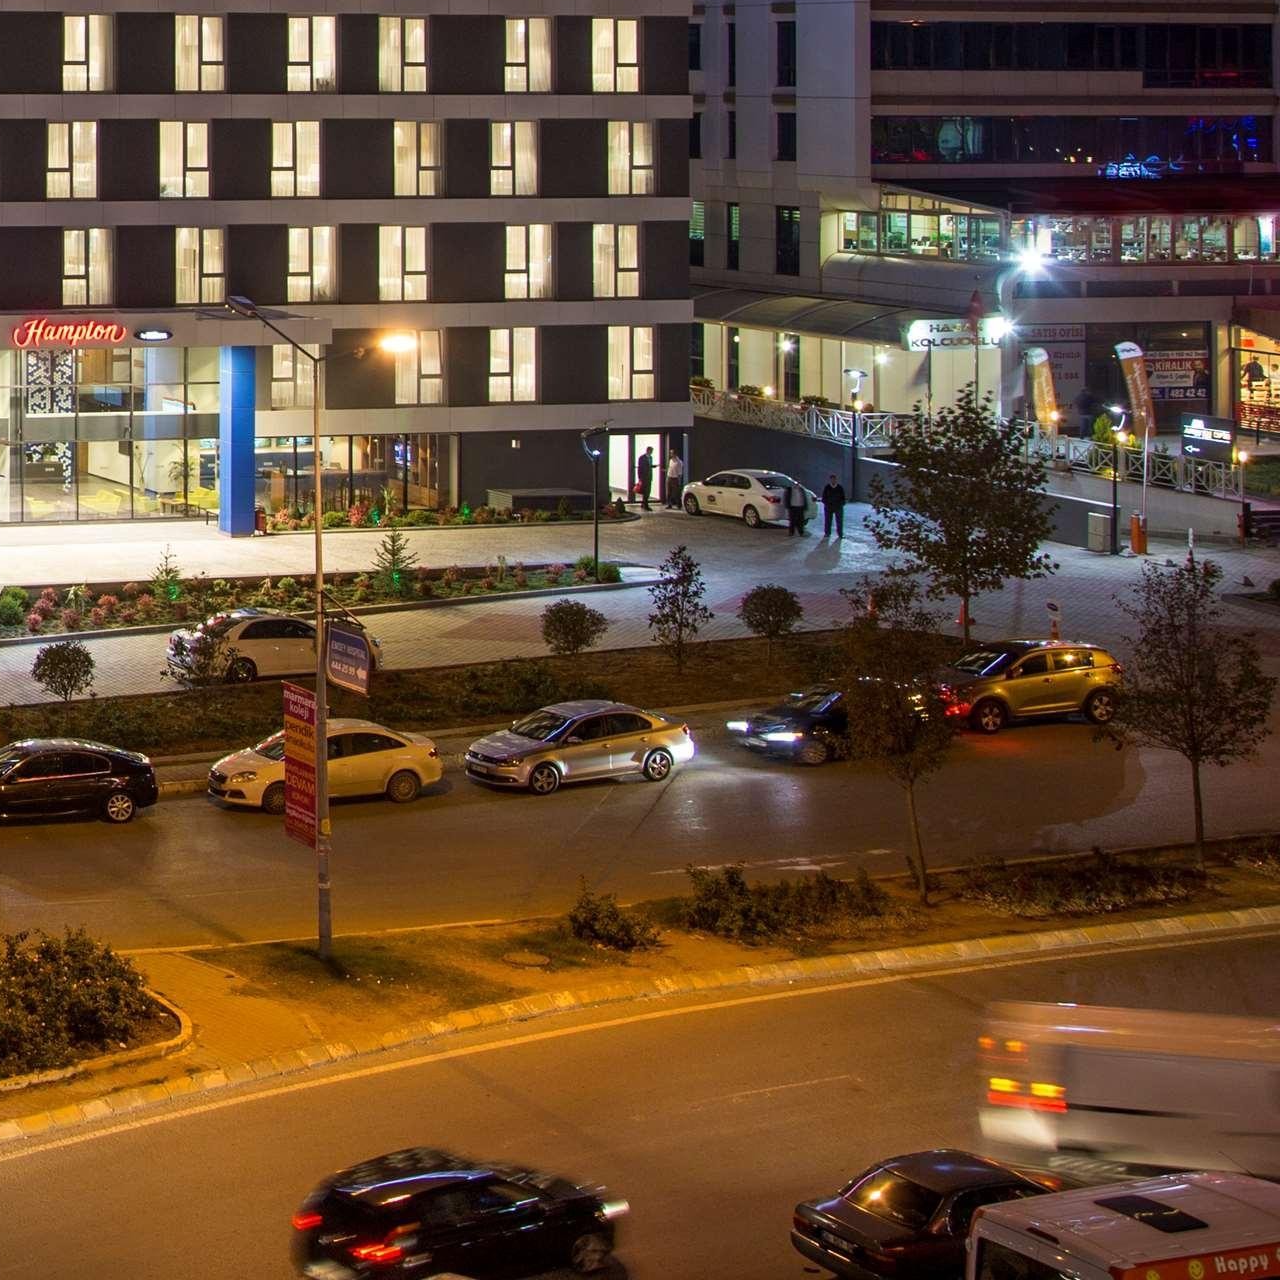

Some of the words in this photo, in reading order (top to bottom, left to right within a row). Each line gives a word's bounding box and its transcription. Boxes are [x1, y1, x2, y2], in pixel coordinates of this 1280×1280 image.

[13, 318, 127, 347] Hampton
[289, 701, 309, 720] koleji
[1214, 1254, 1269, 1274] Happy
